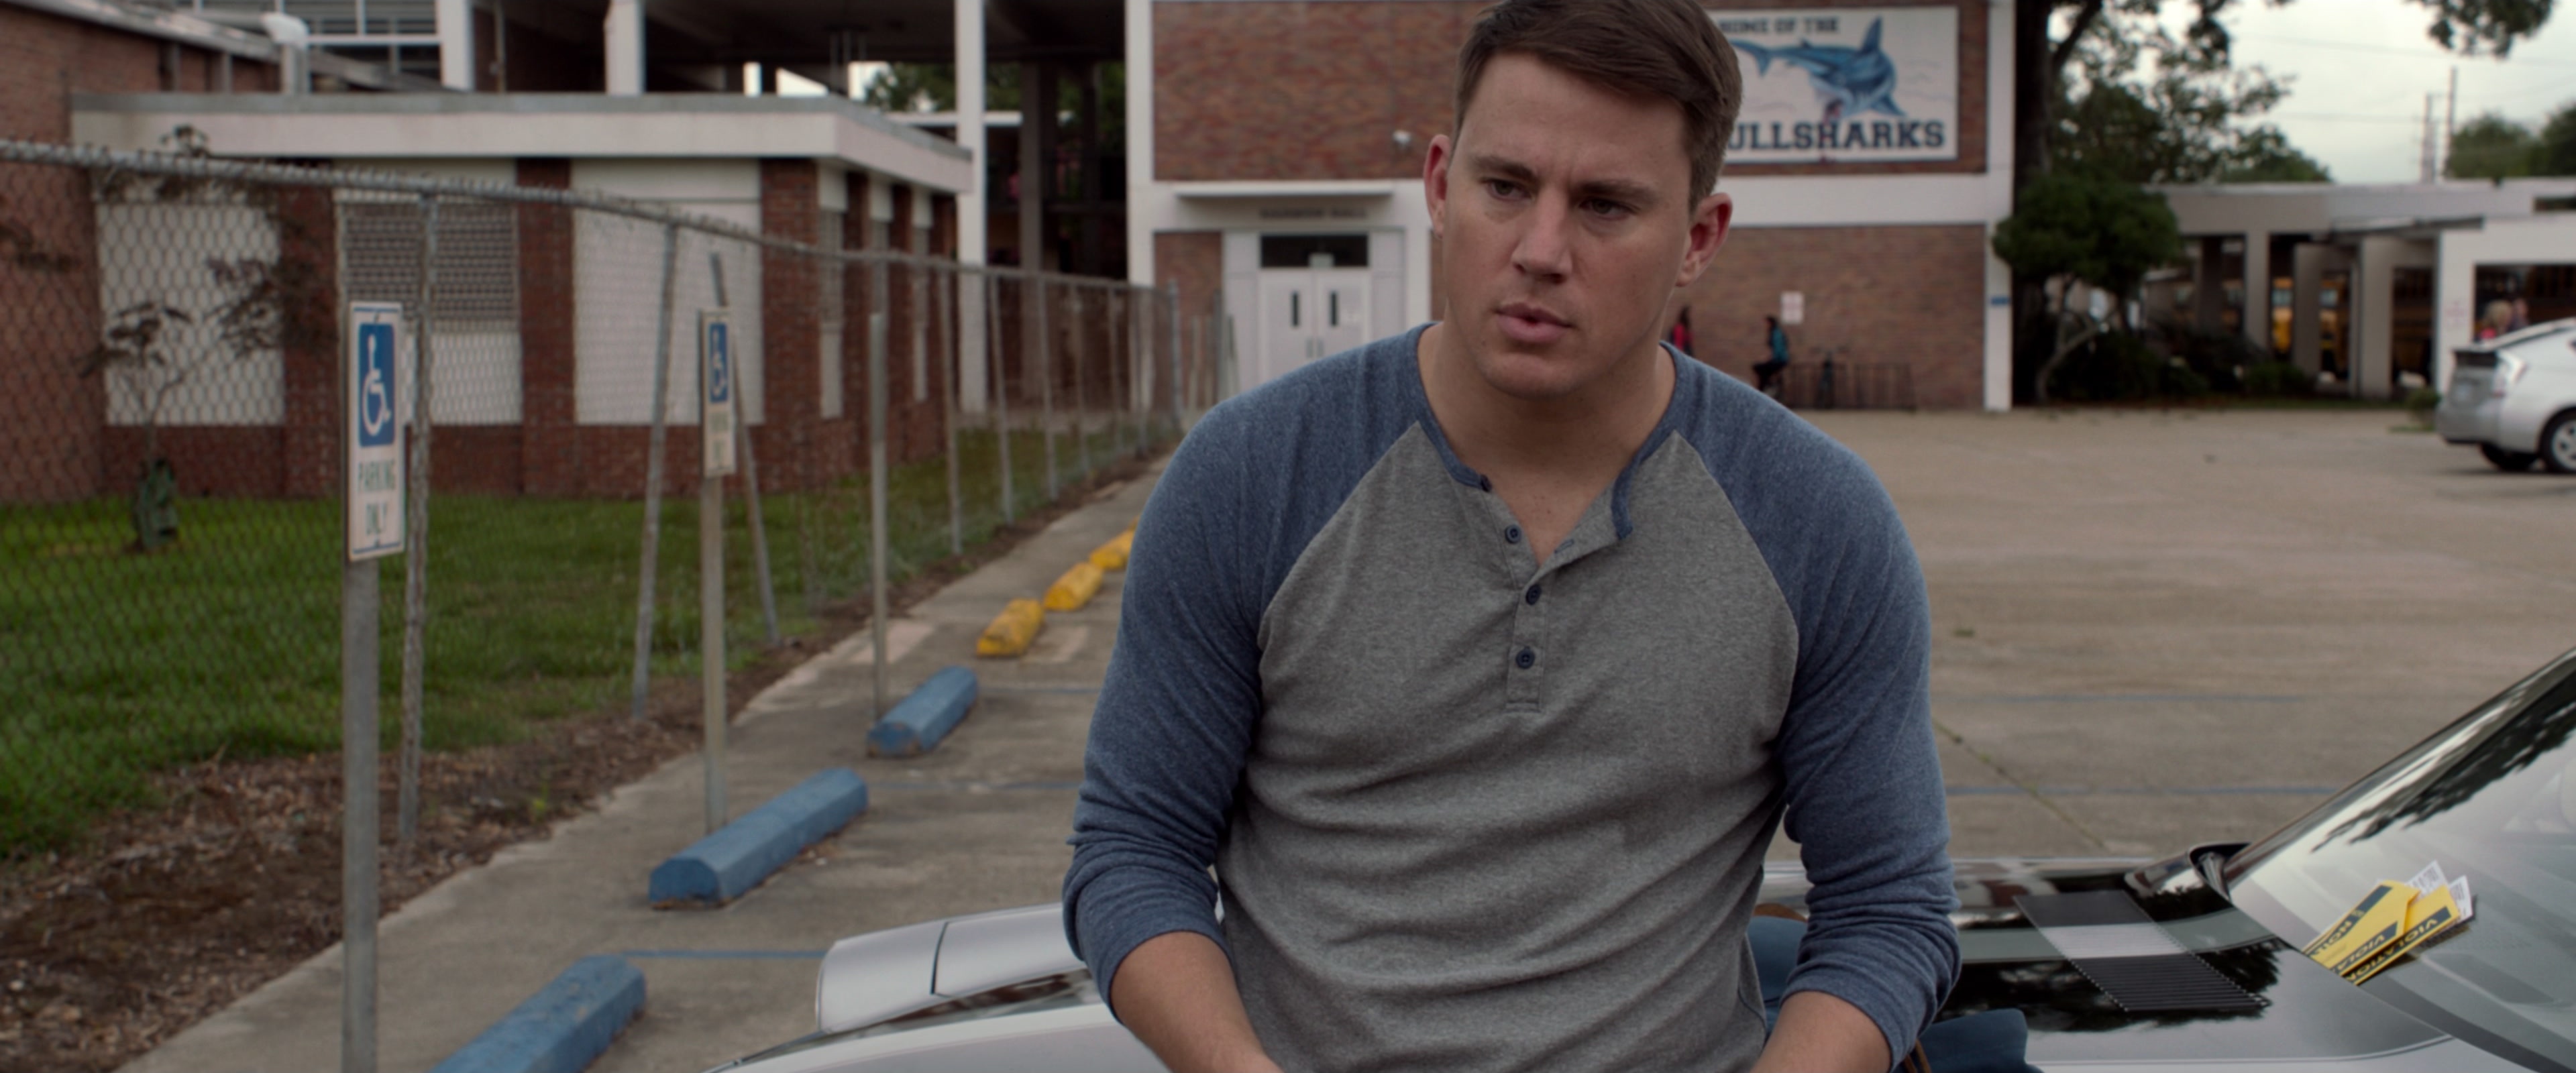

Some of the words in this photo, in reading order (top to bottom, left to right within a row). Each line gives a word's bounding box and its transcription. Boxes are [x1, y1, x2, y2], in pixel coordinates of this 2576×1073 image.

[1775, 17, 1796, 33] OF
[1804, 16, 1839, 32] THE
[1727, 120, 1945, 150] ULLSHARKS
[358, 459, 396, 494] PARKING
[366, 502, 388, 536] ONLY
[2332, 934, 2385, 972] VIOLA
